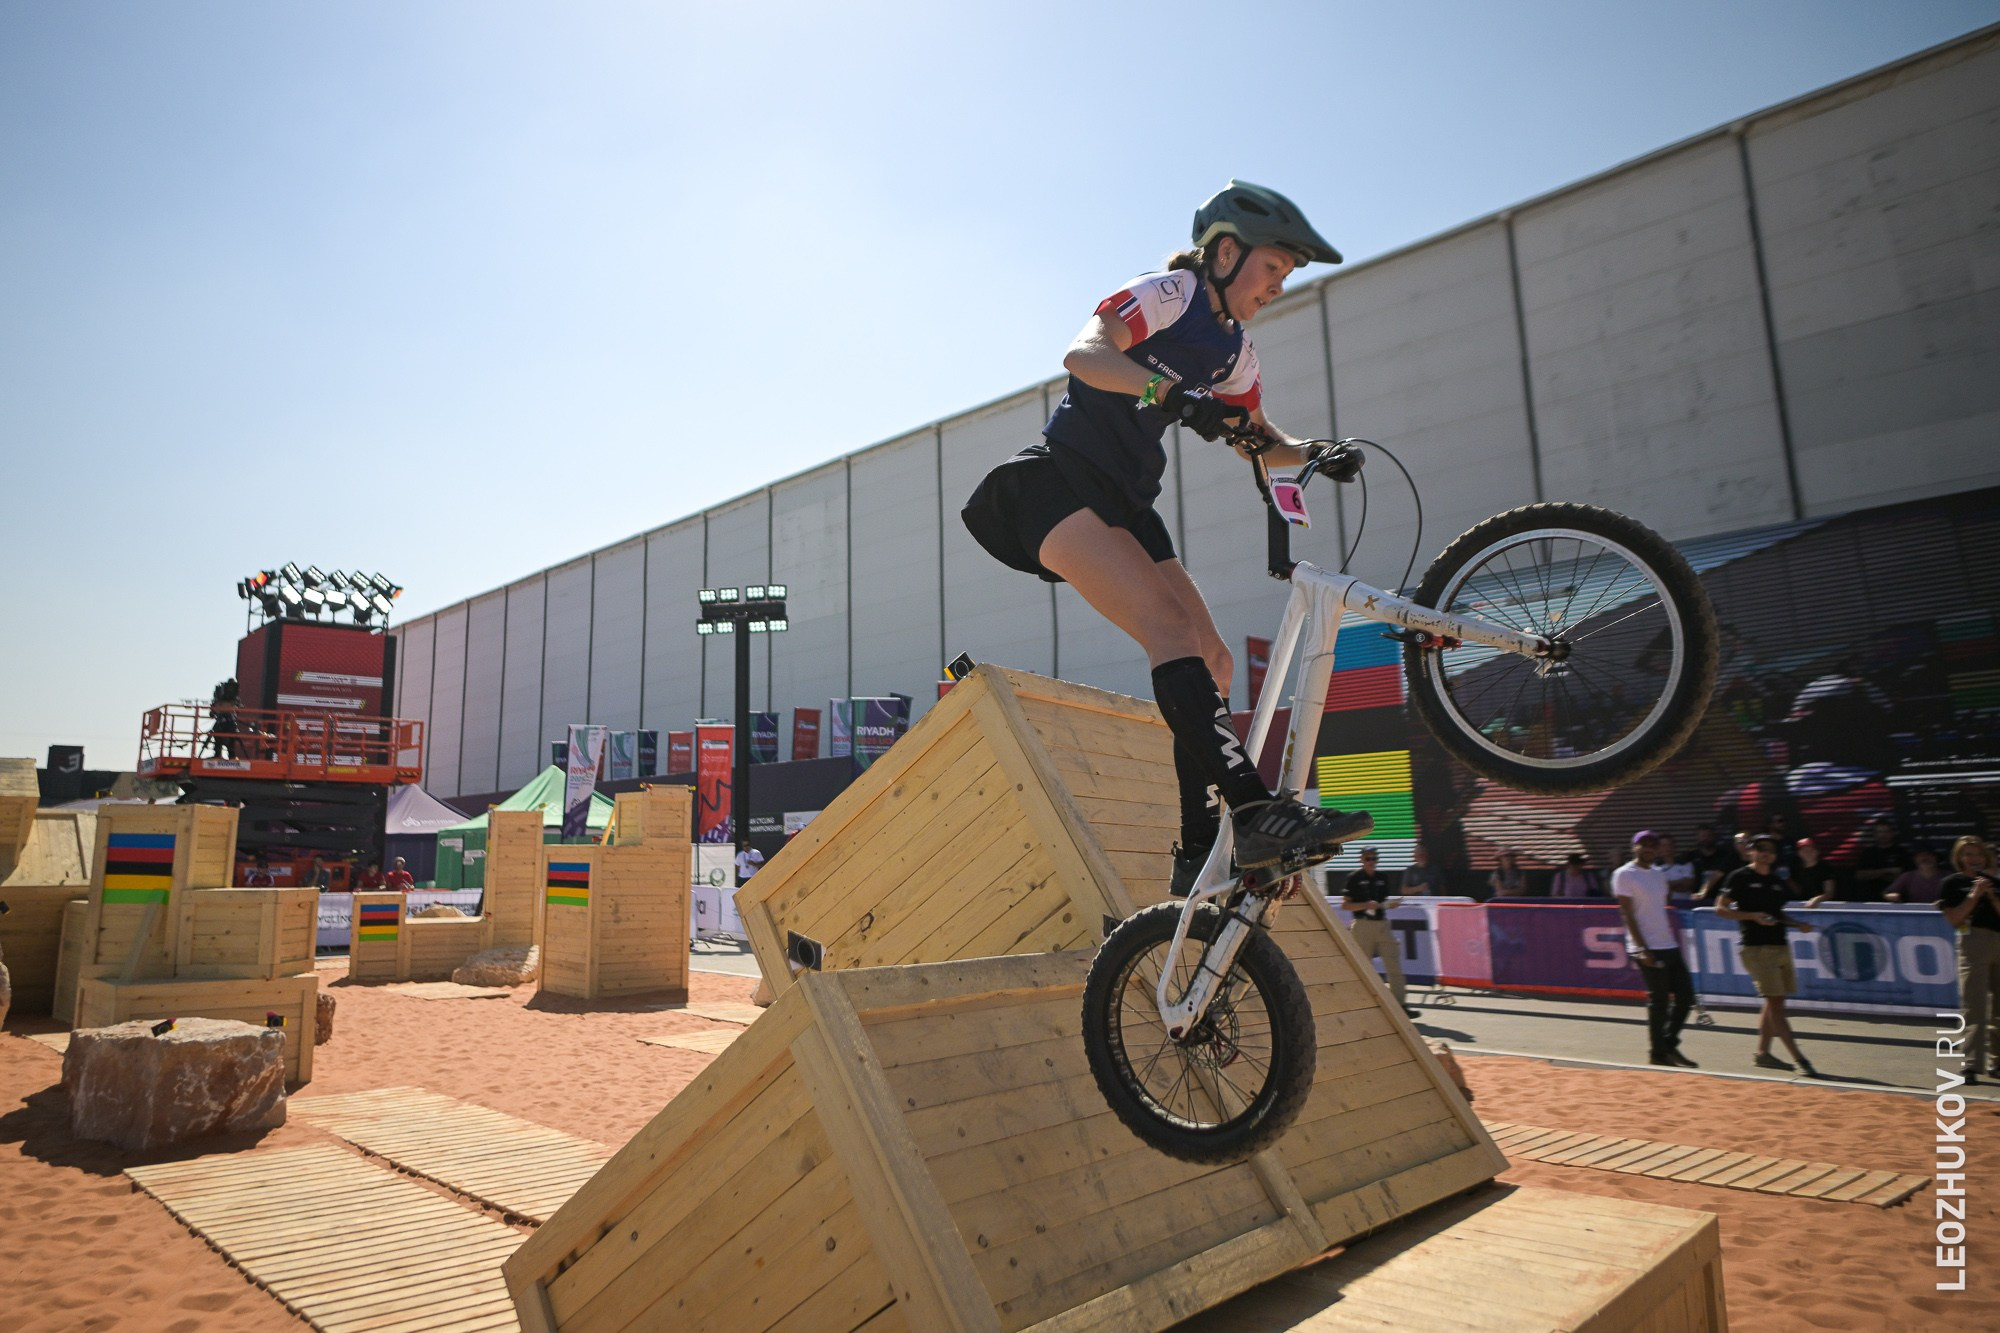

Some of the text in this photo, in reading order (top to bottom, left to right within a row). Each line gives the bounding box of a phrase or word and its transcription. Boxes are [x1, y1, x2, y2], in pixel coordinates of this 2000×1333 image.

[1292, 490, 1302, 510] 6
[751, 731, 777, 739] RIYADH
[856, 725, 895, 736] RIYADH
